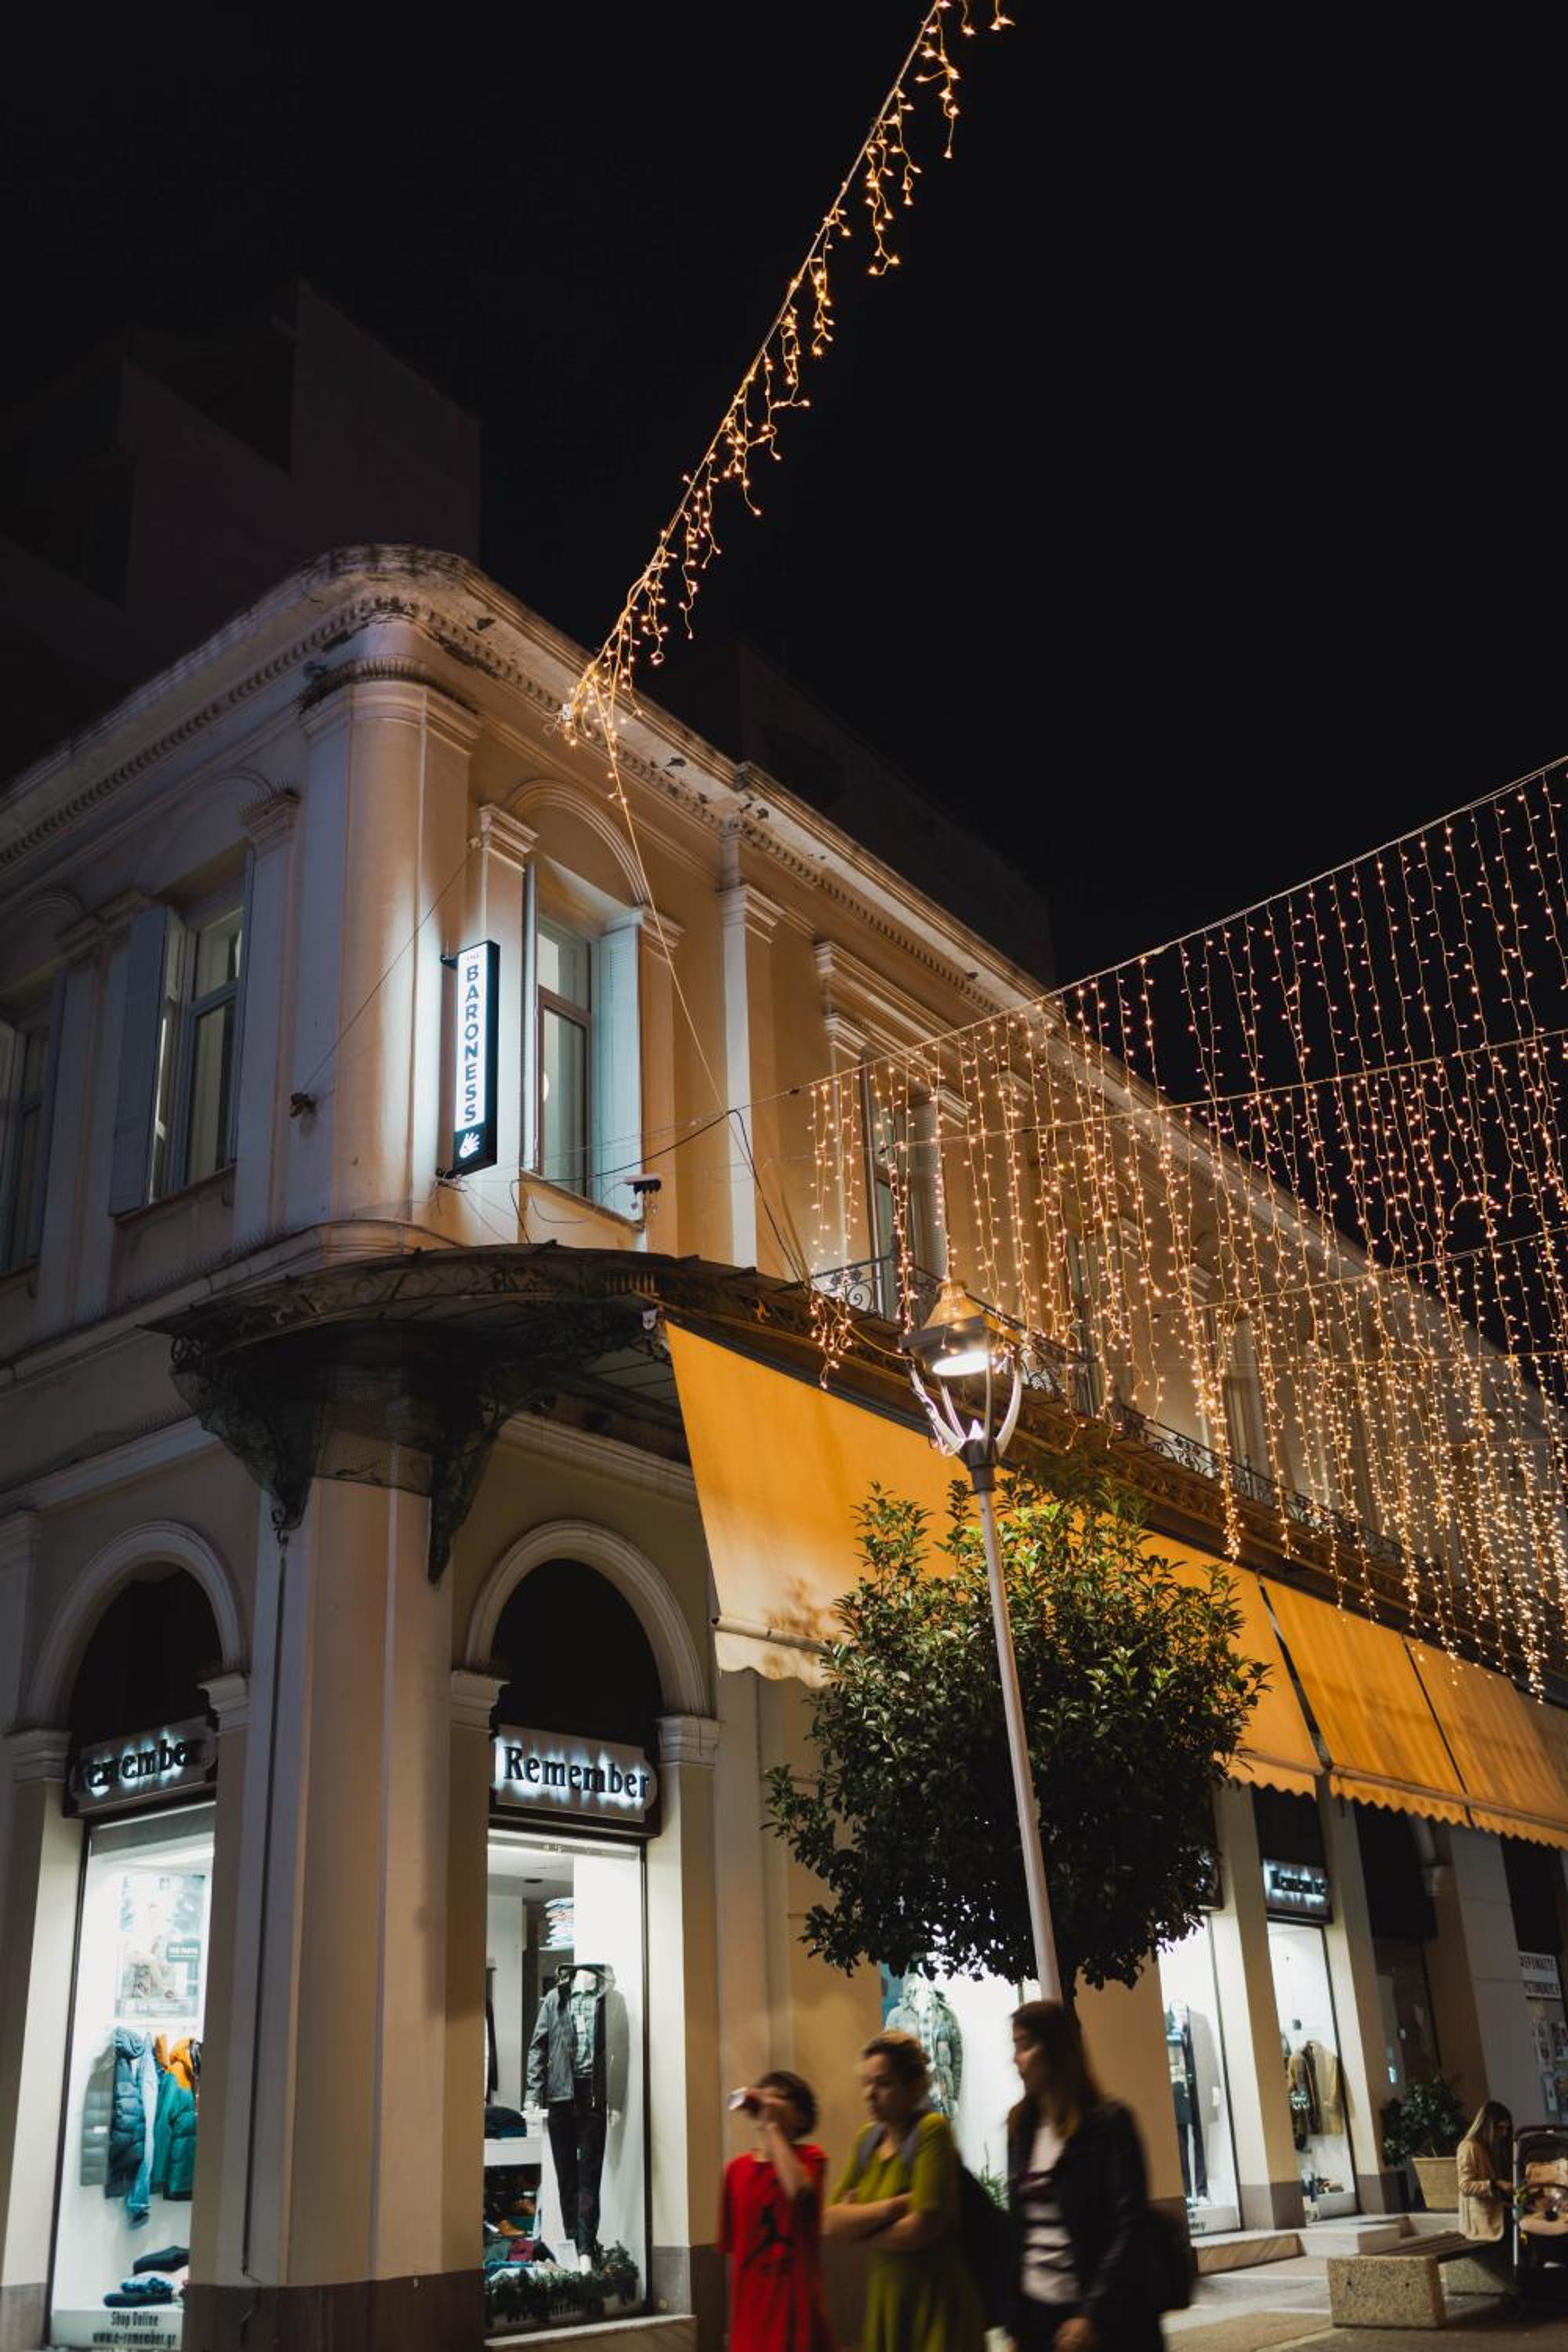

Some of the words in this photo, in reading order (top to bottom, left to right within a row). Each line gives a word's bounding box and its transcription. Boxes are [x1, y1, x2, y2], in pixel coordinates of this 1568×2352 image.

[464, 964, 480, 1123] BARONESS
[503, 1746, 650, 1798] Remember
[111, 2310, 131, 2329] Shop
[132, 2310, 159, 2329] Online
